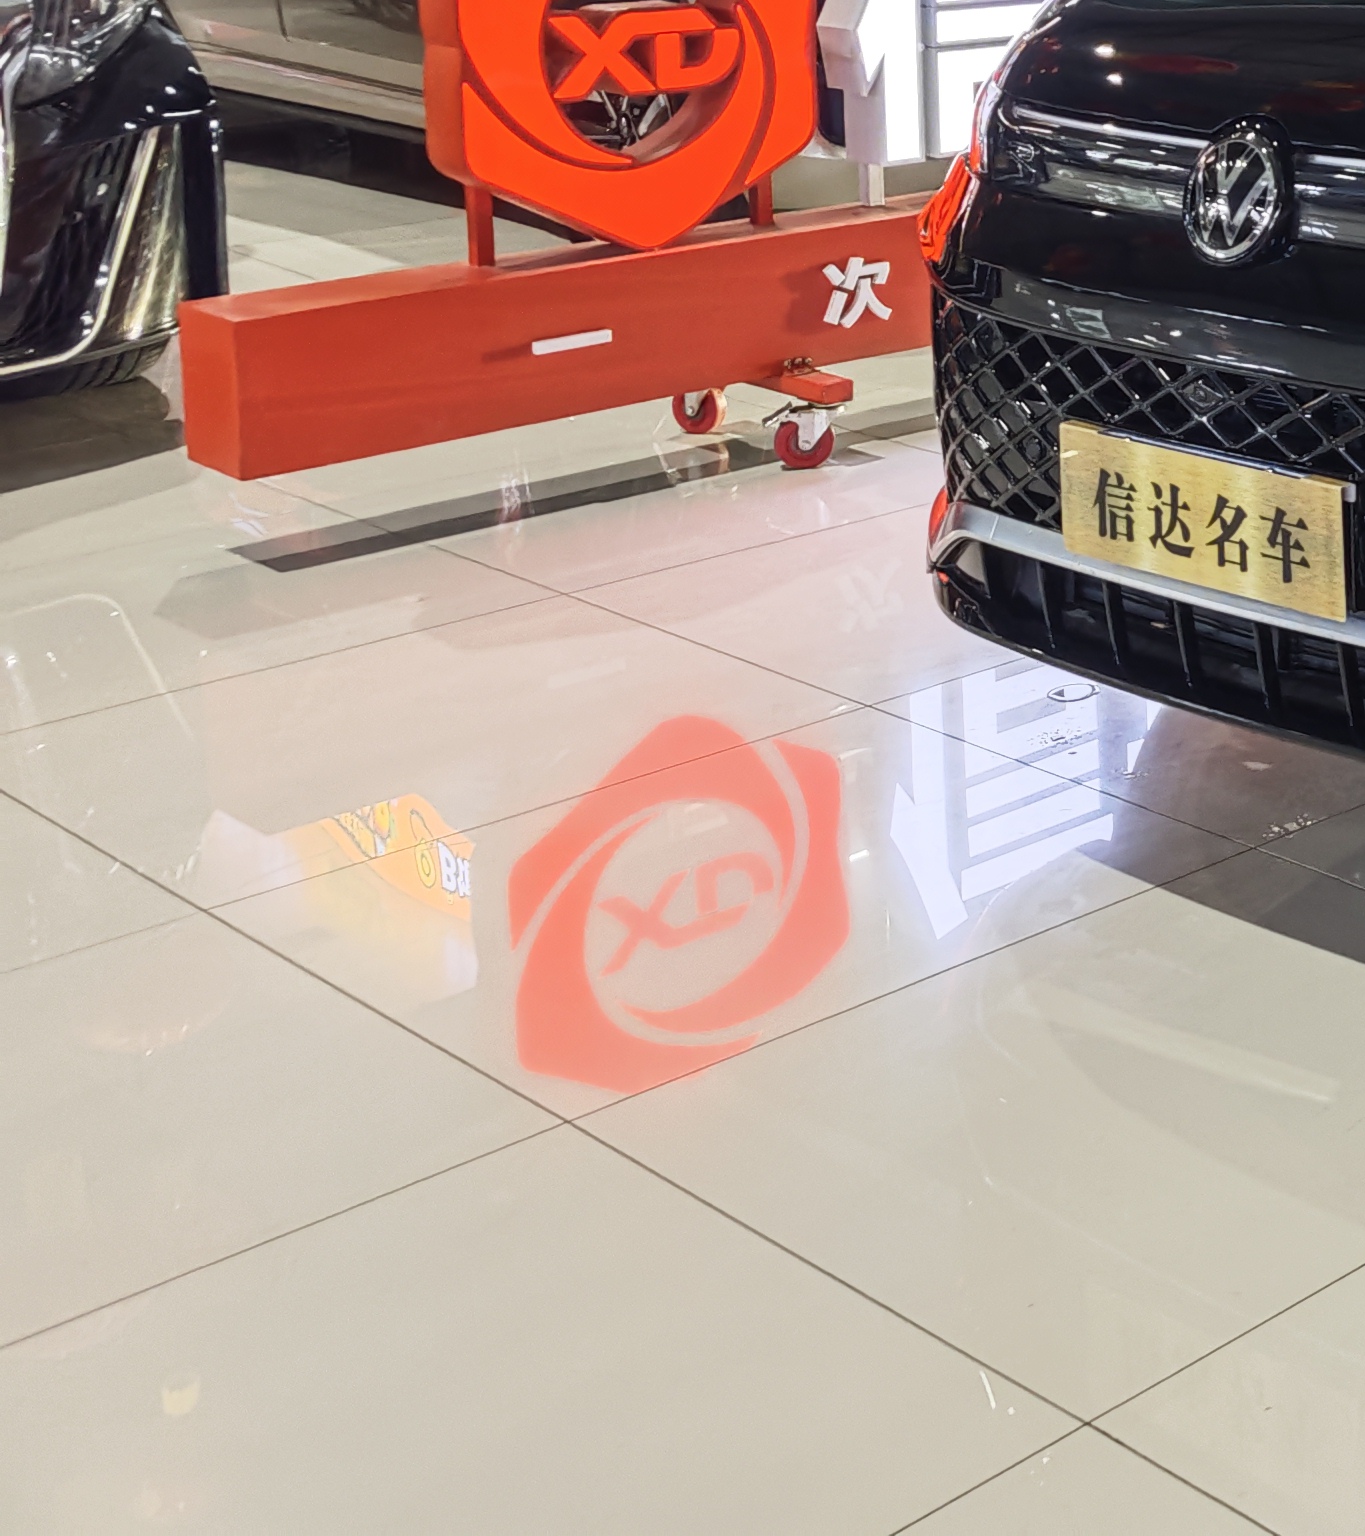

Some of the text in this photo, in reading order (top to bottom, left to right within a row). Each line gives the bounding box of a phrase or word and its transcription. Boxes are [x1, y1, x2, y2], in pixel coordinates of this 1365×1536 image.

[551, 2, 741, 104] XD
[1092, 467, 1311, 584] 信达名车
